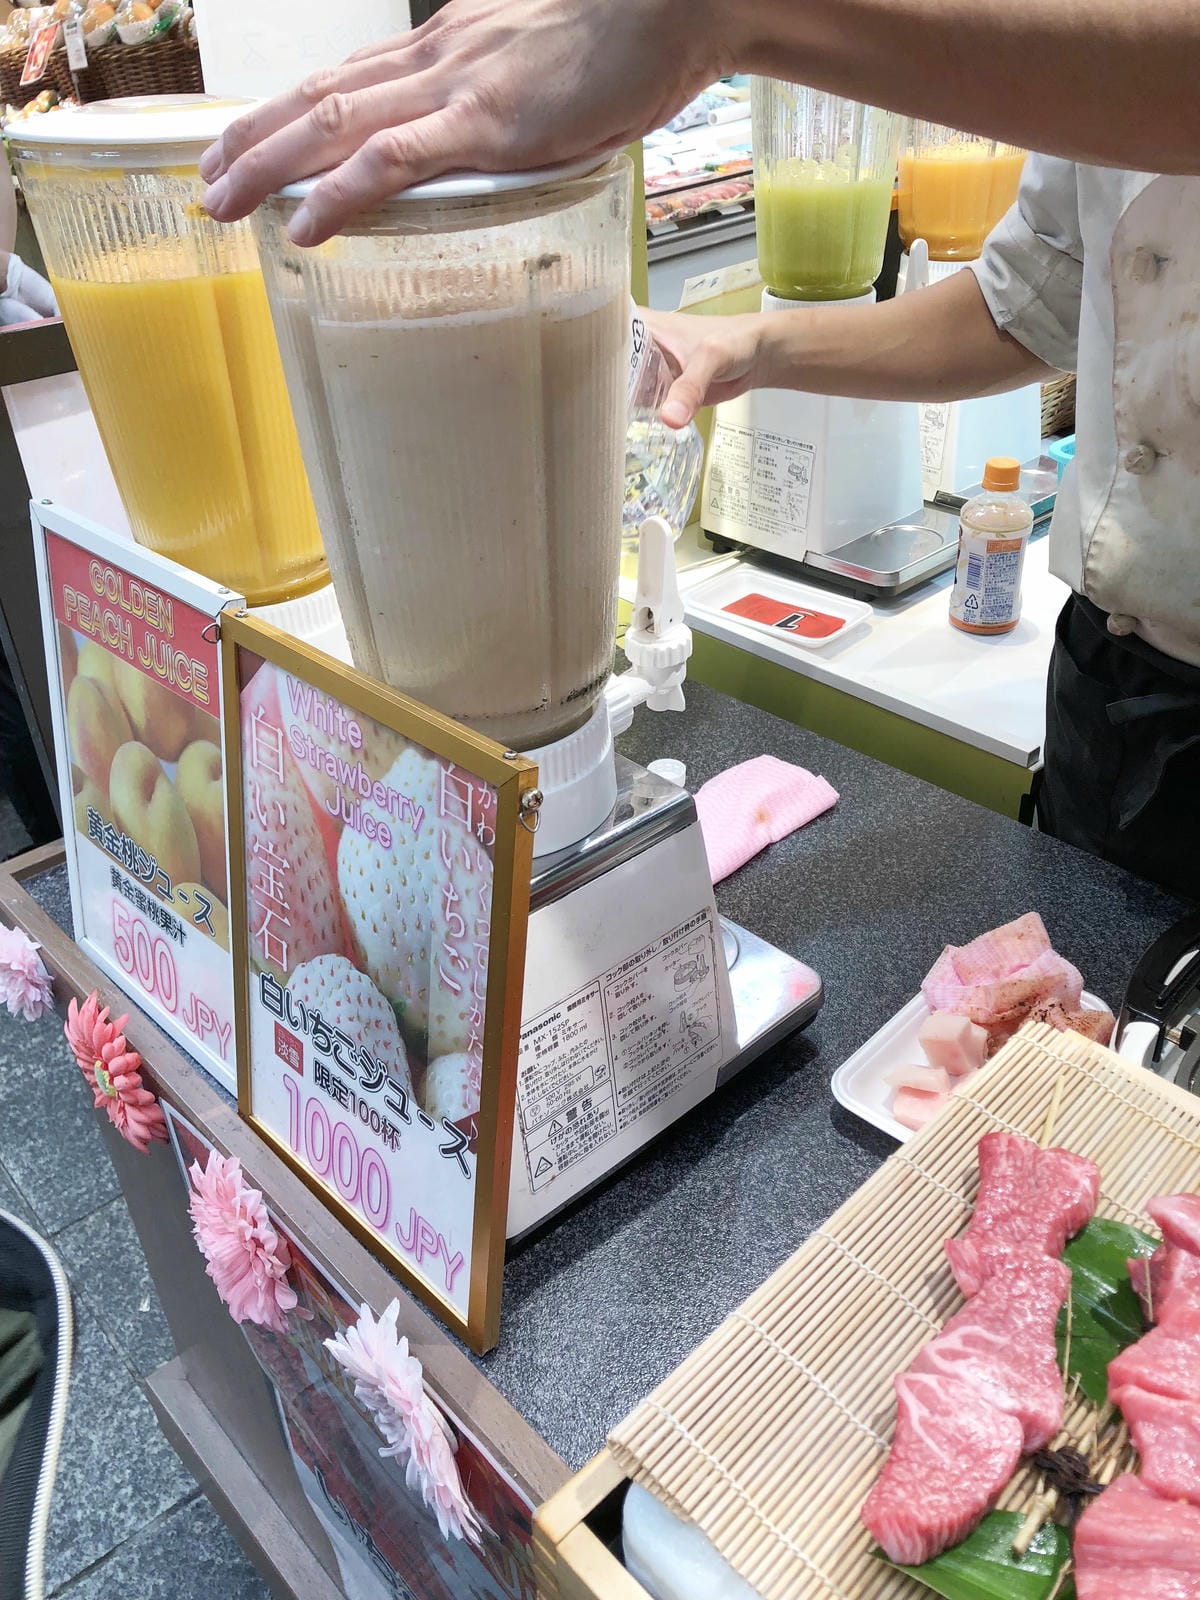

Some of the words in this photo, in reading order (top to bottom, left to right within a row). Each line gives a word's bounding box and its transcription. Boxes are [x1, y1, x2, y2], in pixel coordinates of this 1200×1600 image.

[63, 585, 134, 659] PEACH
[137, 633, 209, 704] JUICE
[89, 559, 174, 637] GOLDEN
[286, 675, 363, 749] White
[289, 724, 425, 832] Strawberry
[326, 785, 392, 849] Juice
[87, 806, 216, 937] 黄金桃ジュース
[250, 705, 291, 973] 白い宝石
[438, 762, 474, 992] 白いちご
[109, 865, 188, 948] 黄金蜜桃果汁
[113, 897, 178, 1014] 500
[182, 992, 232, 1061] JPY
[518, 1011, 563, 1040] anasonic
[259, 972, 472, 1179] 白いちごジュース
[313, 1058, 402, 1152] 限定100杯
[565, 1094, 592, 1124] 警告
[282, 1072, 391, 1232] 1000
[396, 1207, 464, 1293] JPY
